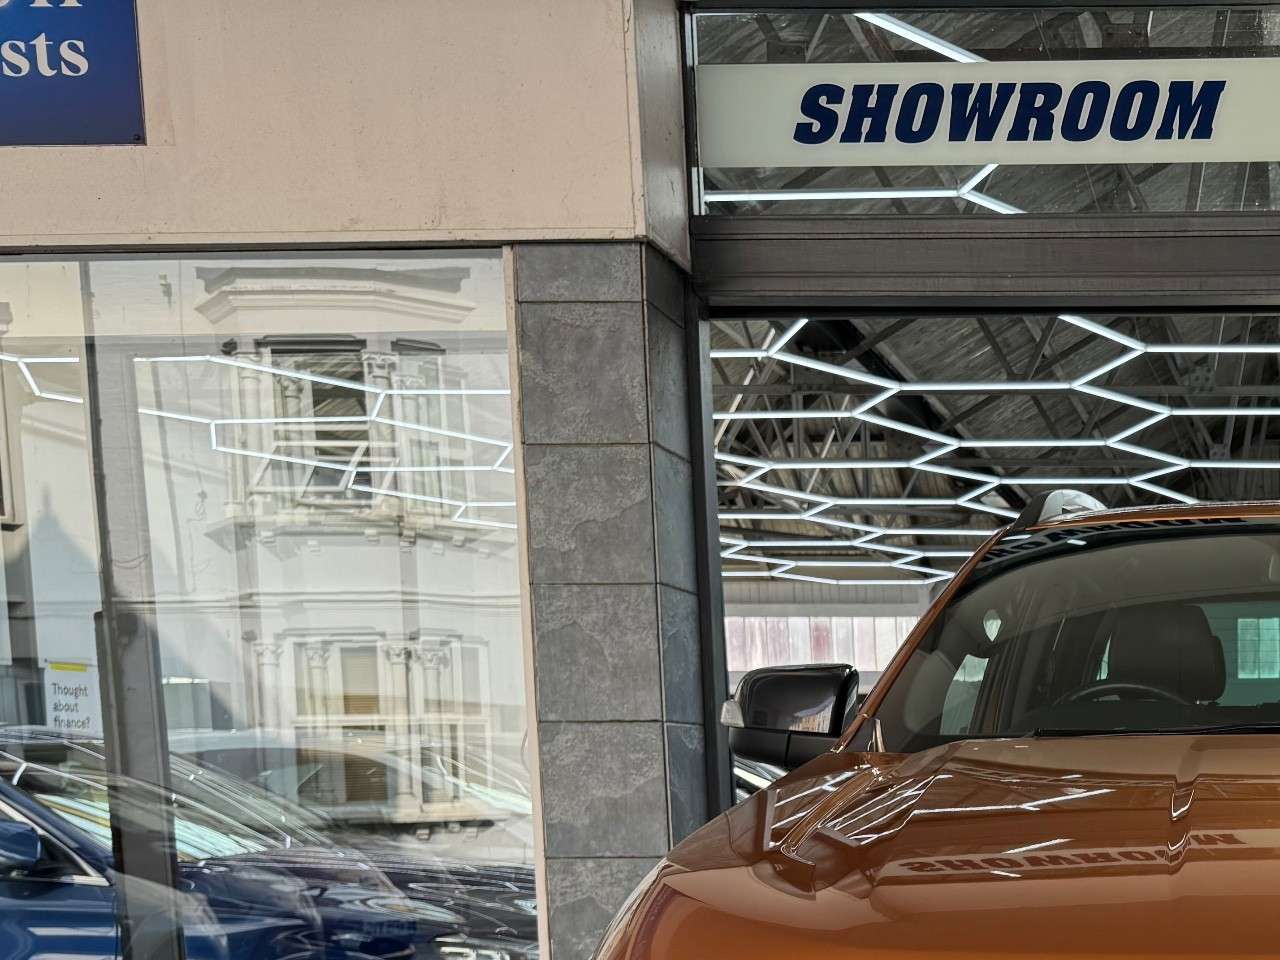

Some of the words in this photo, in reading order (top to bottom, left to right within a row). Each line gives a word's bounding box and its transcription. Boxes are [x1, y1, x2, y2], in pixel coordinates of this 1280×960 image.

[793, 80, 1227, 144] SHOWROOM
[51, 682, 88, 699] Thought
[53, 701, 79, 712] about
[54, 715, 90, 729] finance?
